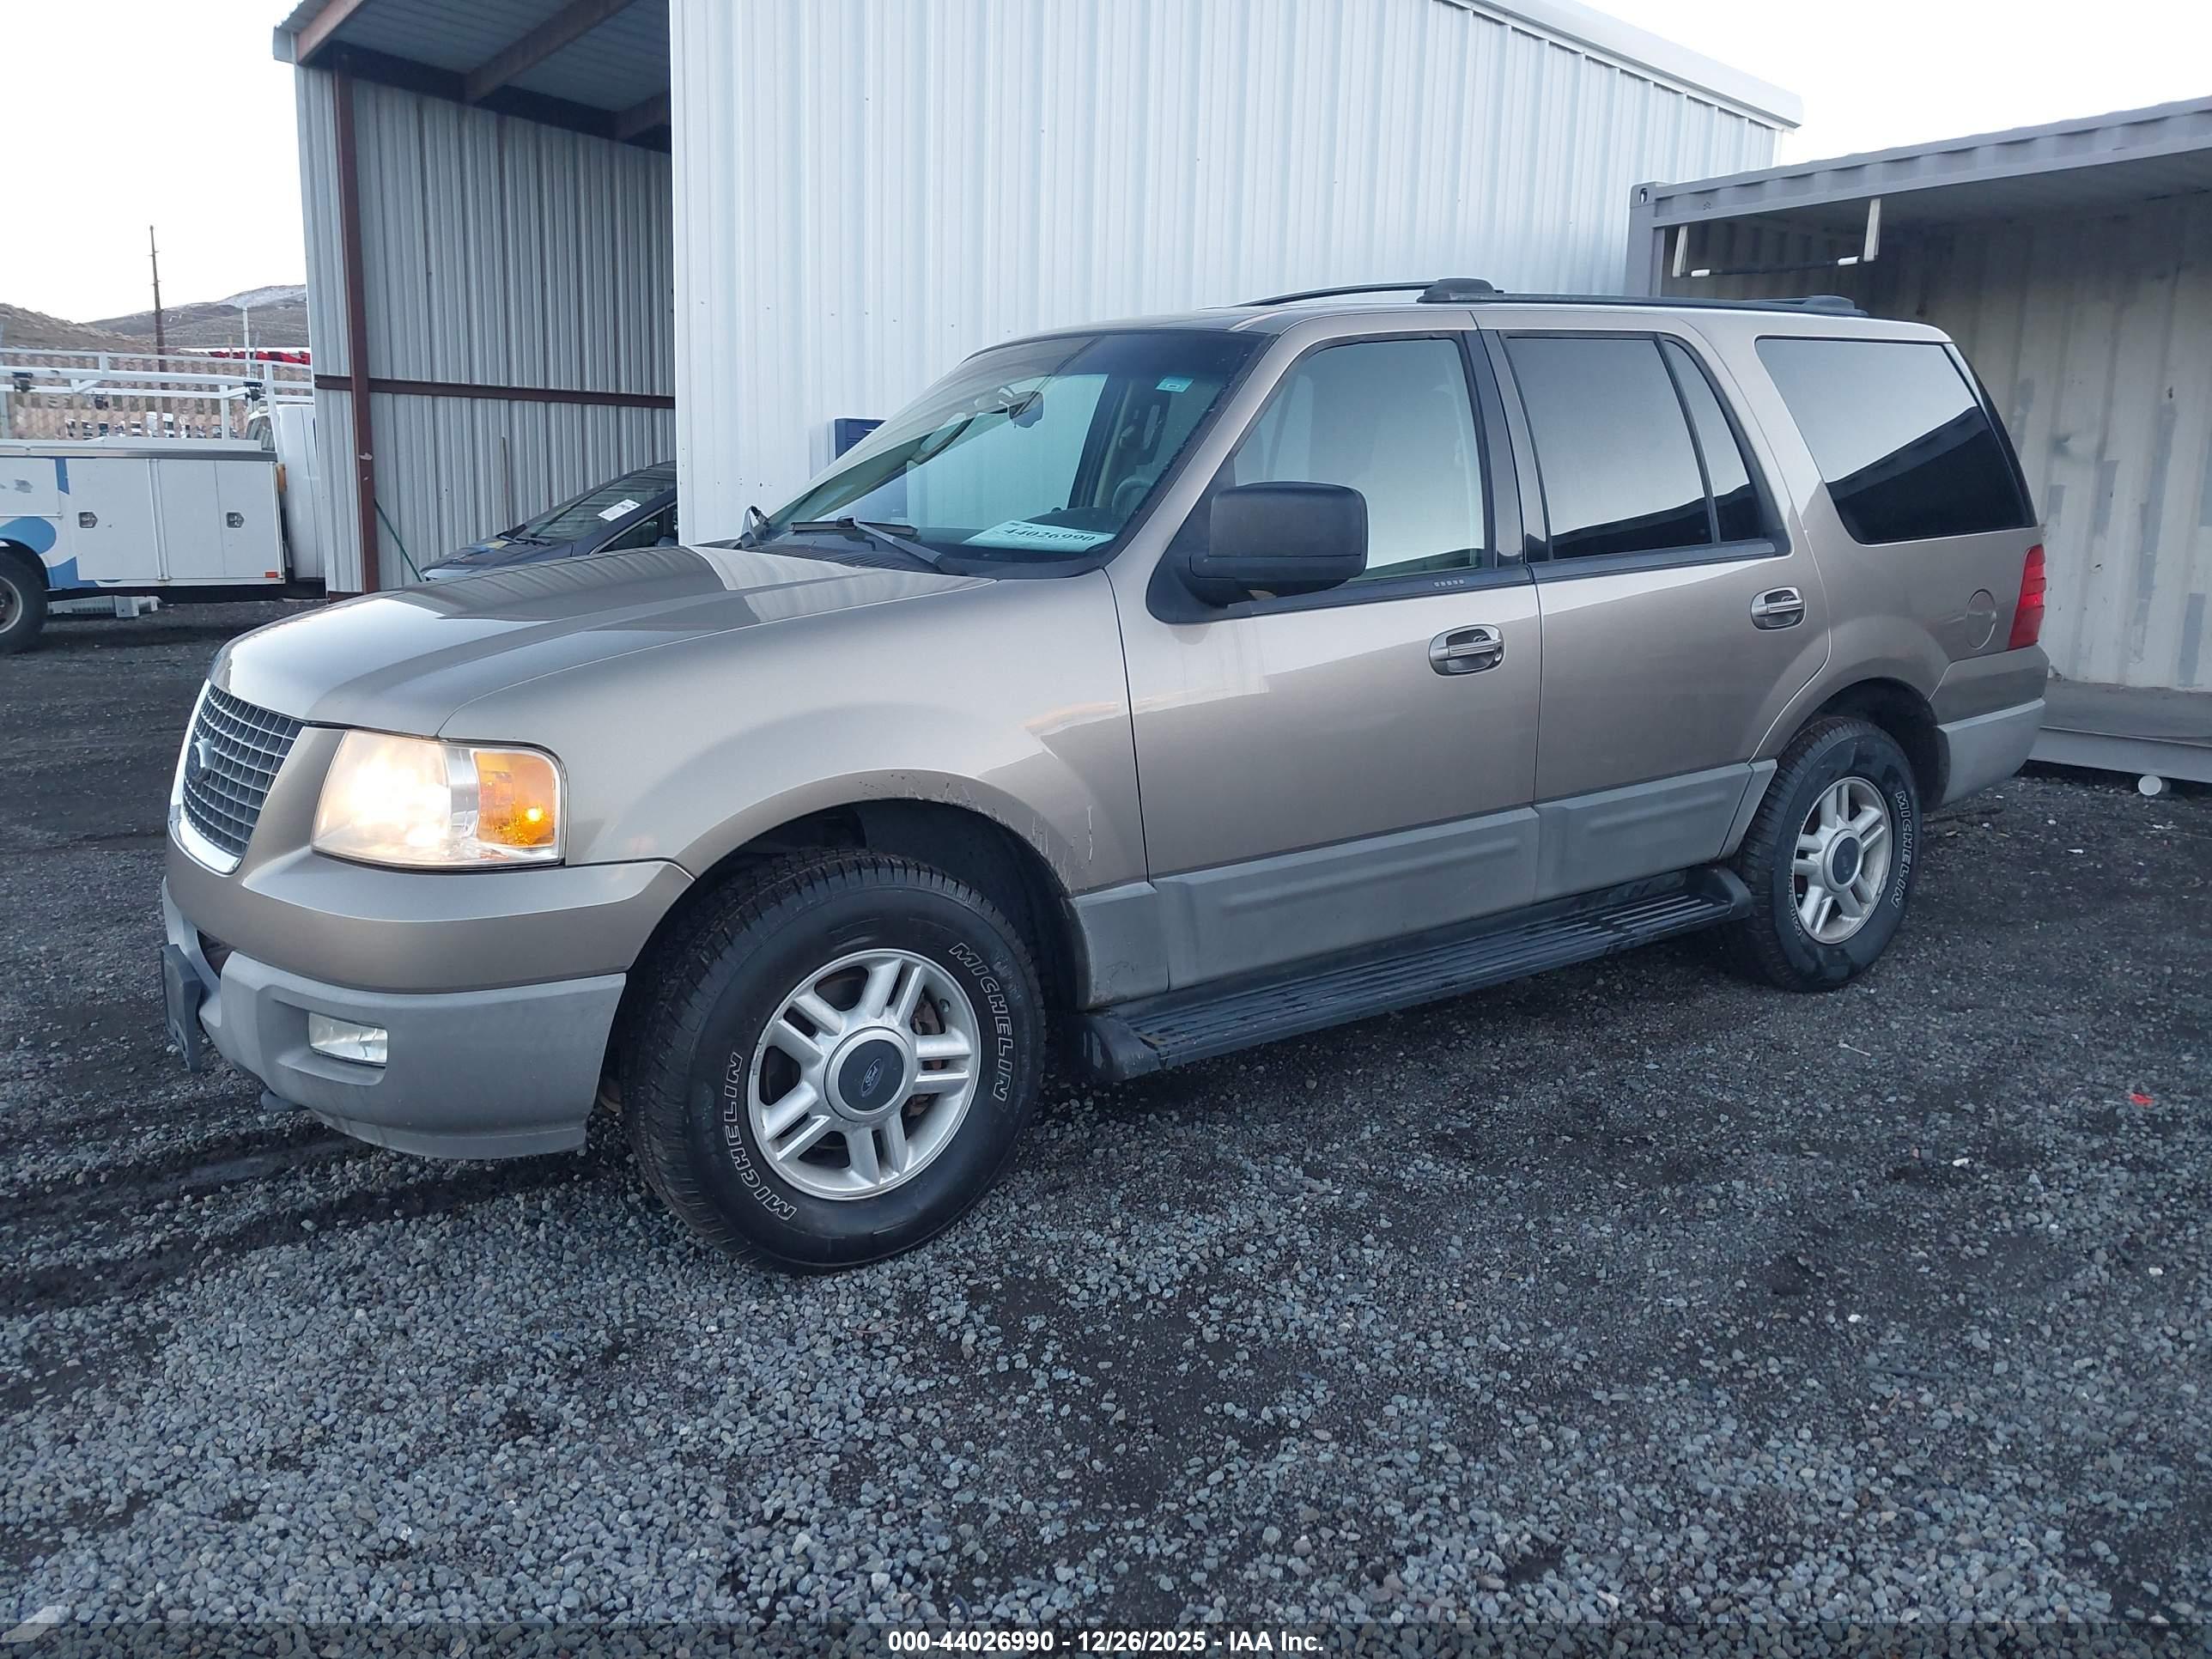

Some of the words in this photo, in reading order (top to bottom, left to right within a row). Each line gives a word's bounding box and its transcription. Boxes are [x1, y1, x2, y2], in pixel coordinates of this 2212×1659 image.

[1004, 527, 1097, 542] 44026990
[1891, 790, 1913, 908] MICHELIN
[948, 942, 1013, 1102] MICHELIN
[724, 1052, 798, 1220] MICHELIN
